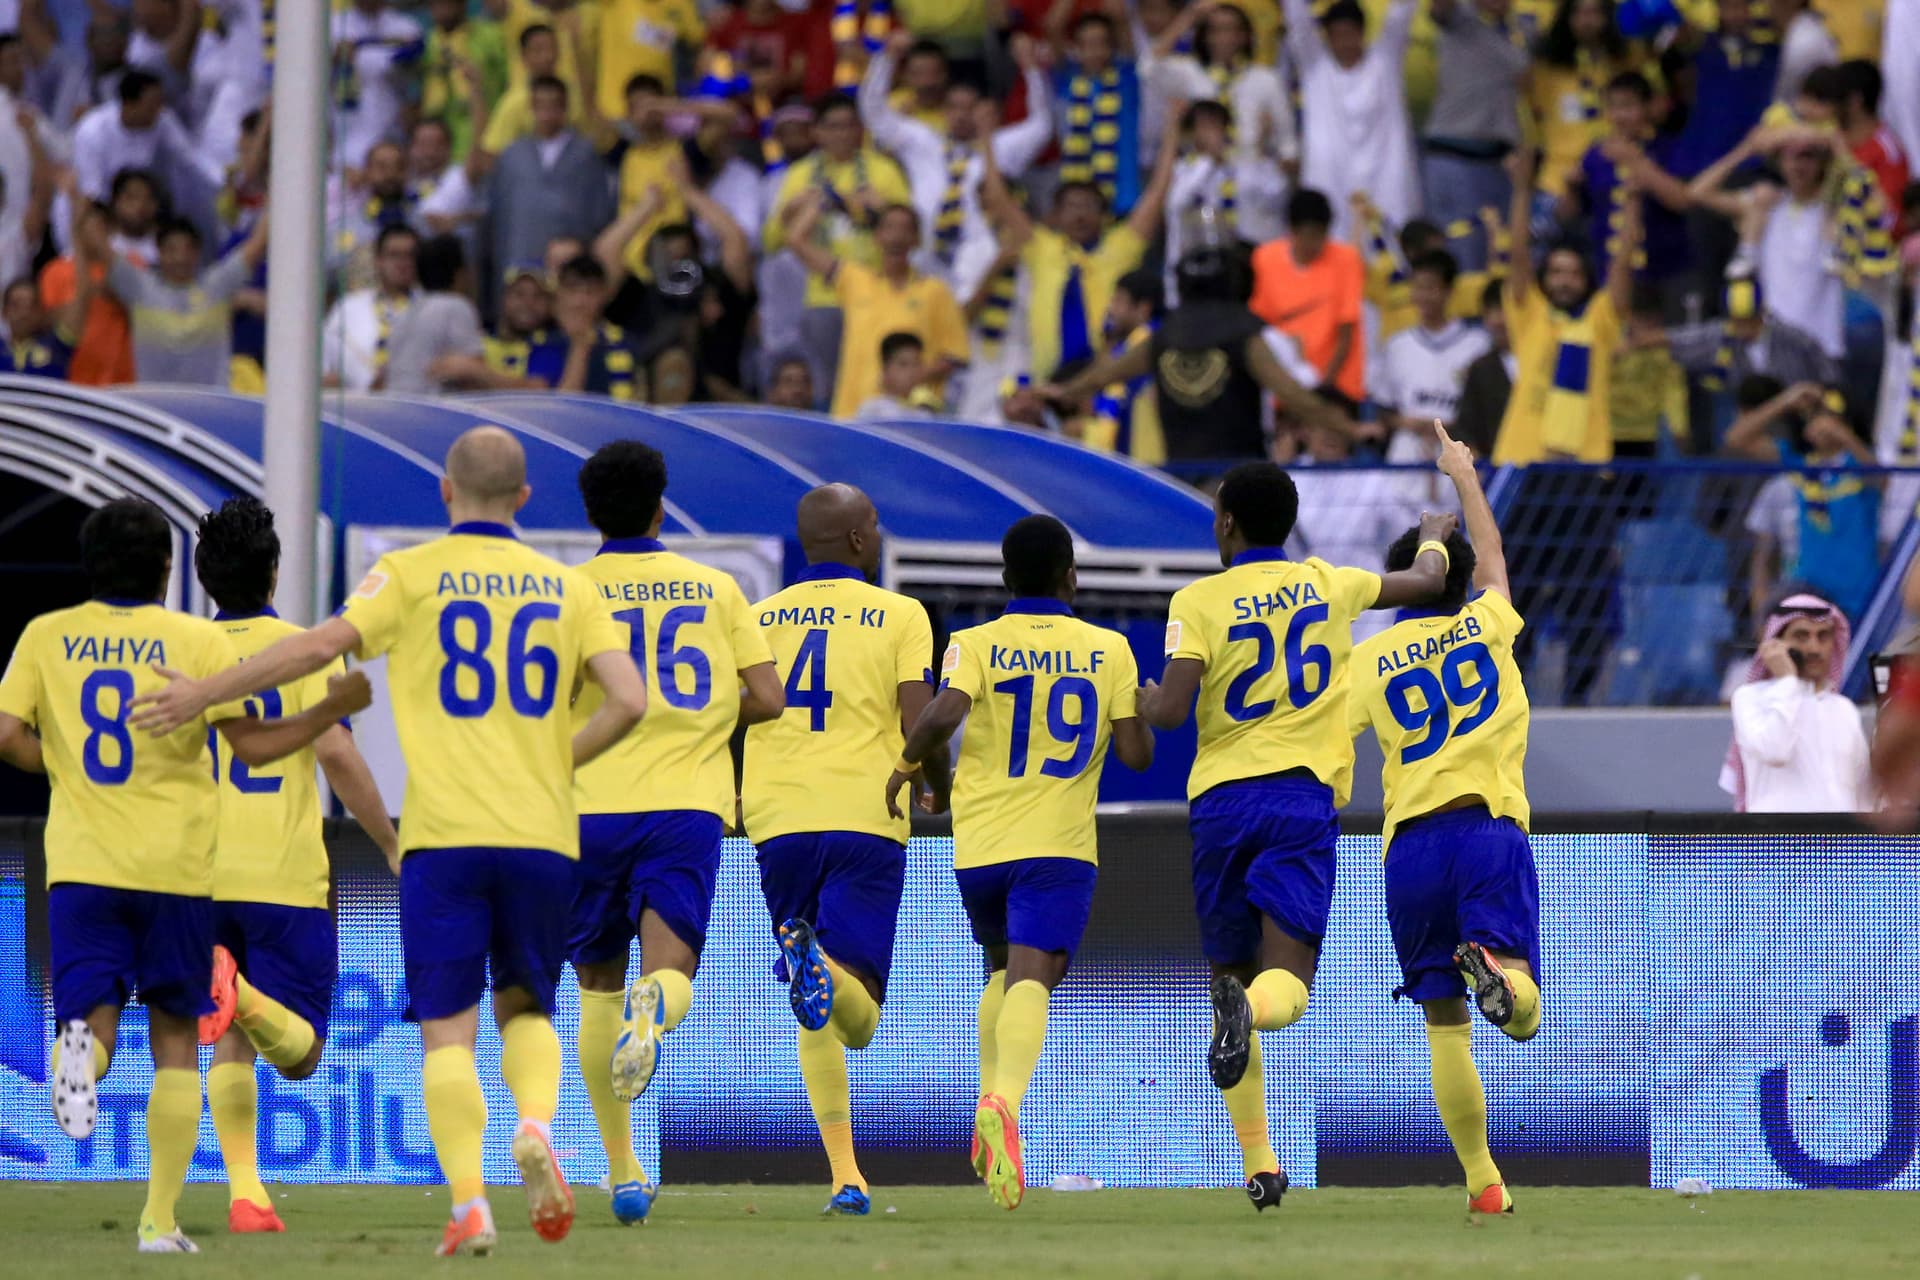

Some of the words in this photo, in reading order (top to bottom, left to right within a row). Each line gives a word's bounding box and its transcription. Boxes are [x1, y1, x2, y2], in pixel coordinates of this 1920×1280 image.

[437, 571, 564, 598] ADRIAN
[760, 607, 835, 627] OMAR
[860, 607, 885, 628] KI
[1233, 582, 1323, 621] SHAYA
[63, 635, 166, 666] YAHYA
[438, 600, 561, 719] 86
[611, 605, 711, 712] 16
[785, 628, 833, 732] 4
[990, 644, 1104, 674] KAMIL.F
[1224, 602, 1331, 722] 26
[1377, 616, 1482, 677] ALRAHEB
[80, 669, 135, 785] 8
[994, 674, 1098, 779] 19
[1385, 641, 1499, 765] 99
